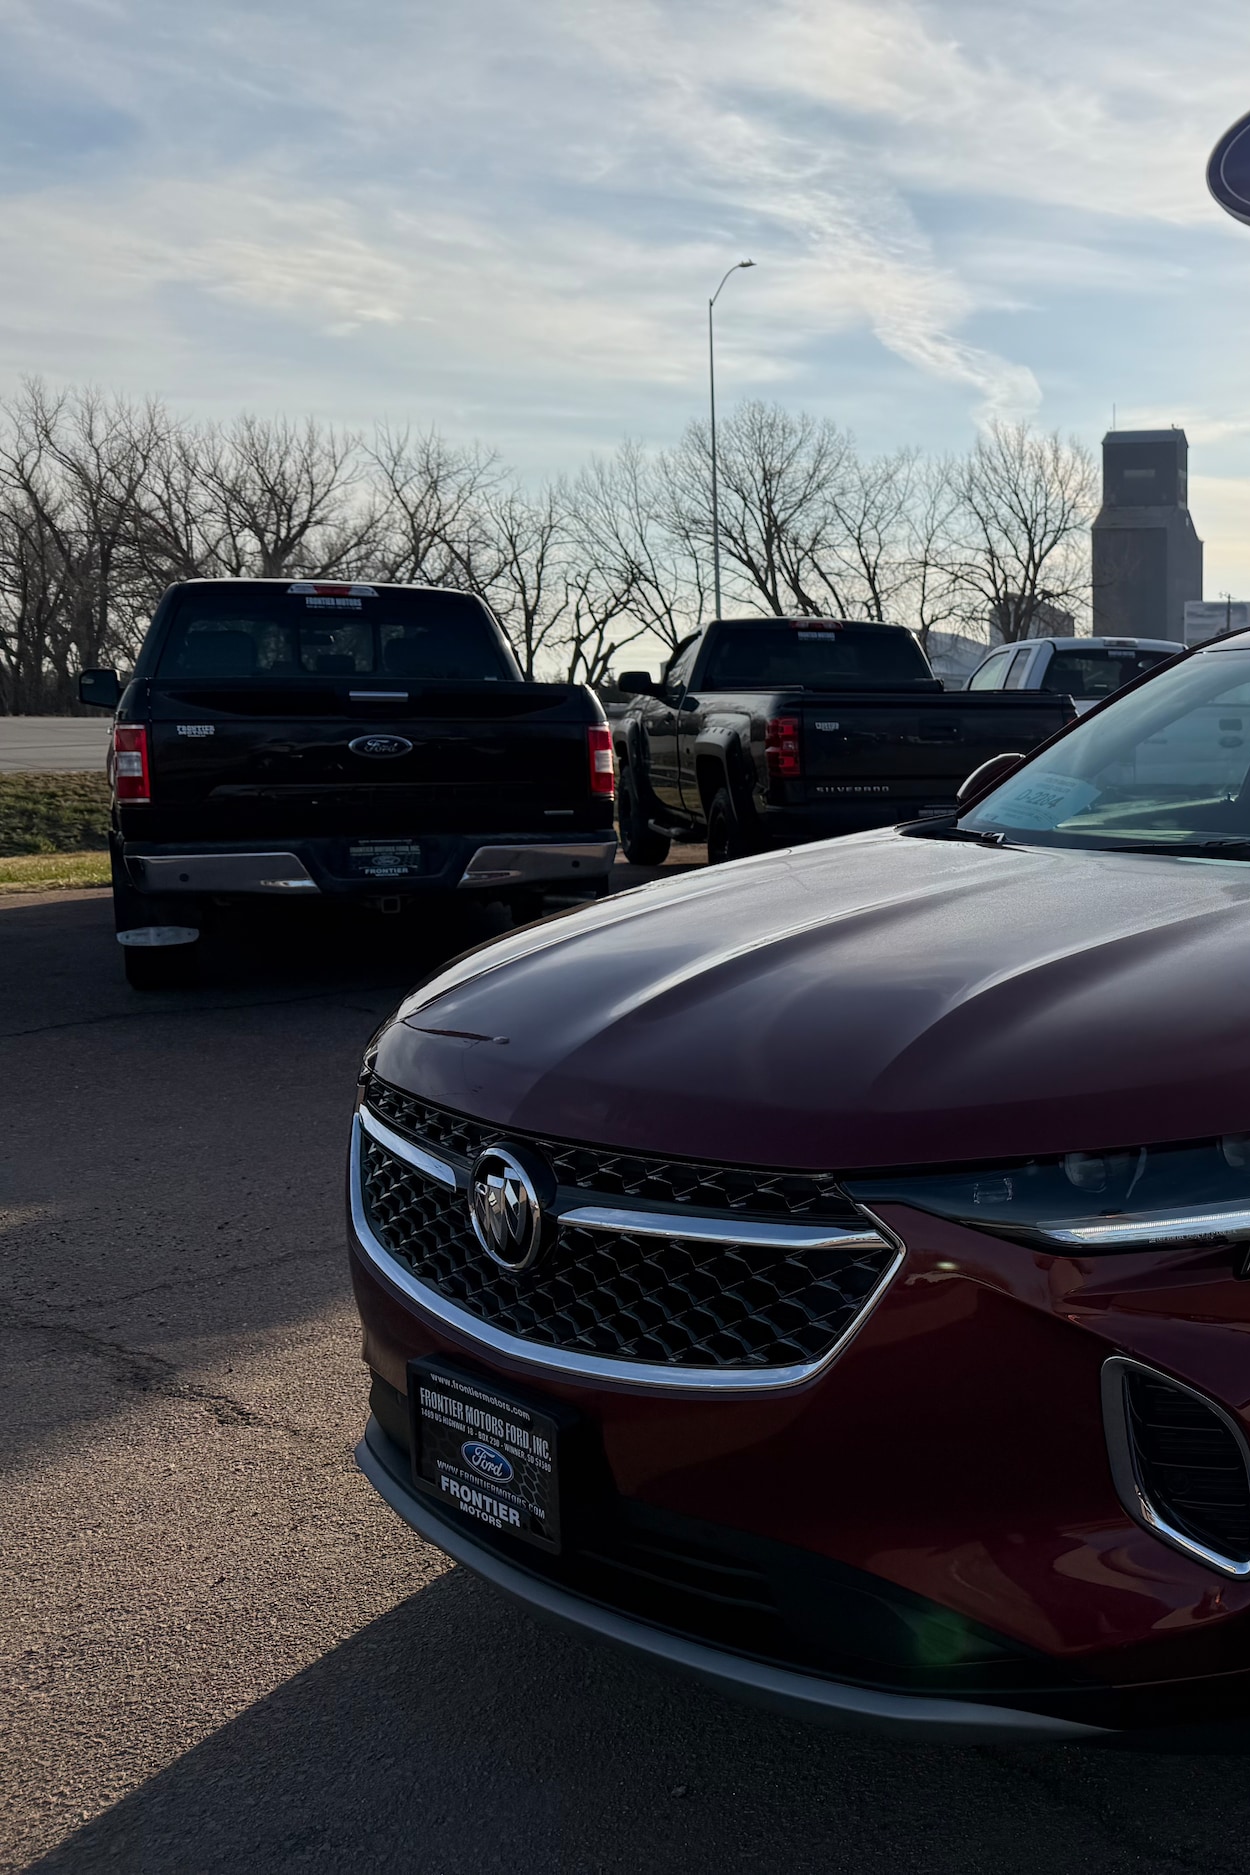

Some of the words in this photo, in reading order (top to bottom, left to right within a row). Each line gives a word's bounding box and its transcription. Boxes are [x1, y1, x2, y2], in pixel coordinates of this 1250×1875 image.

[364, 739, 398, 752] Ford
[430, 1373, 531, 1421] www.frontiermotors.com
[419, 1387, 464, 1421] FRONTIER
[465, 1405, 504, 1438] MOTORS
[505, 1422, 532, 1453] FORD,
[532, 1433, 552, 1461] INC.
[442, 1415, 466, 1432] HIGHWAY
[478, 1430, 489, 1443] BOX
[471, 1446, 503, 1477] Ford
[440, 1474, 521, 1528] FRONTIER
[459, 1500, 503, 1529] MOTORS
